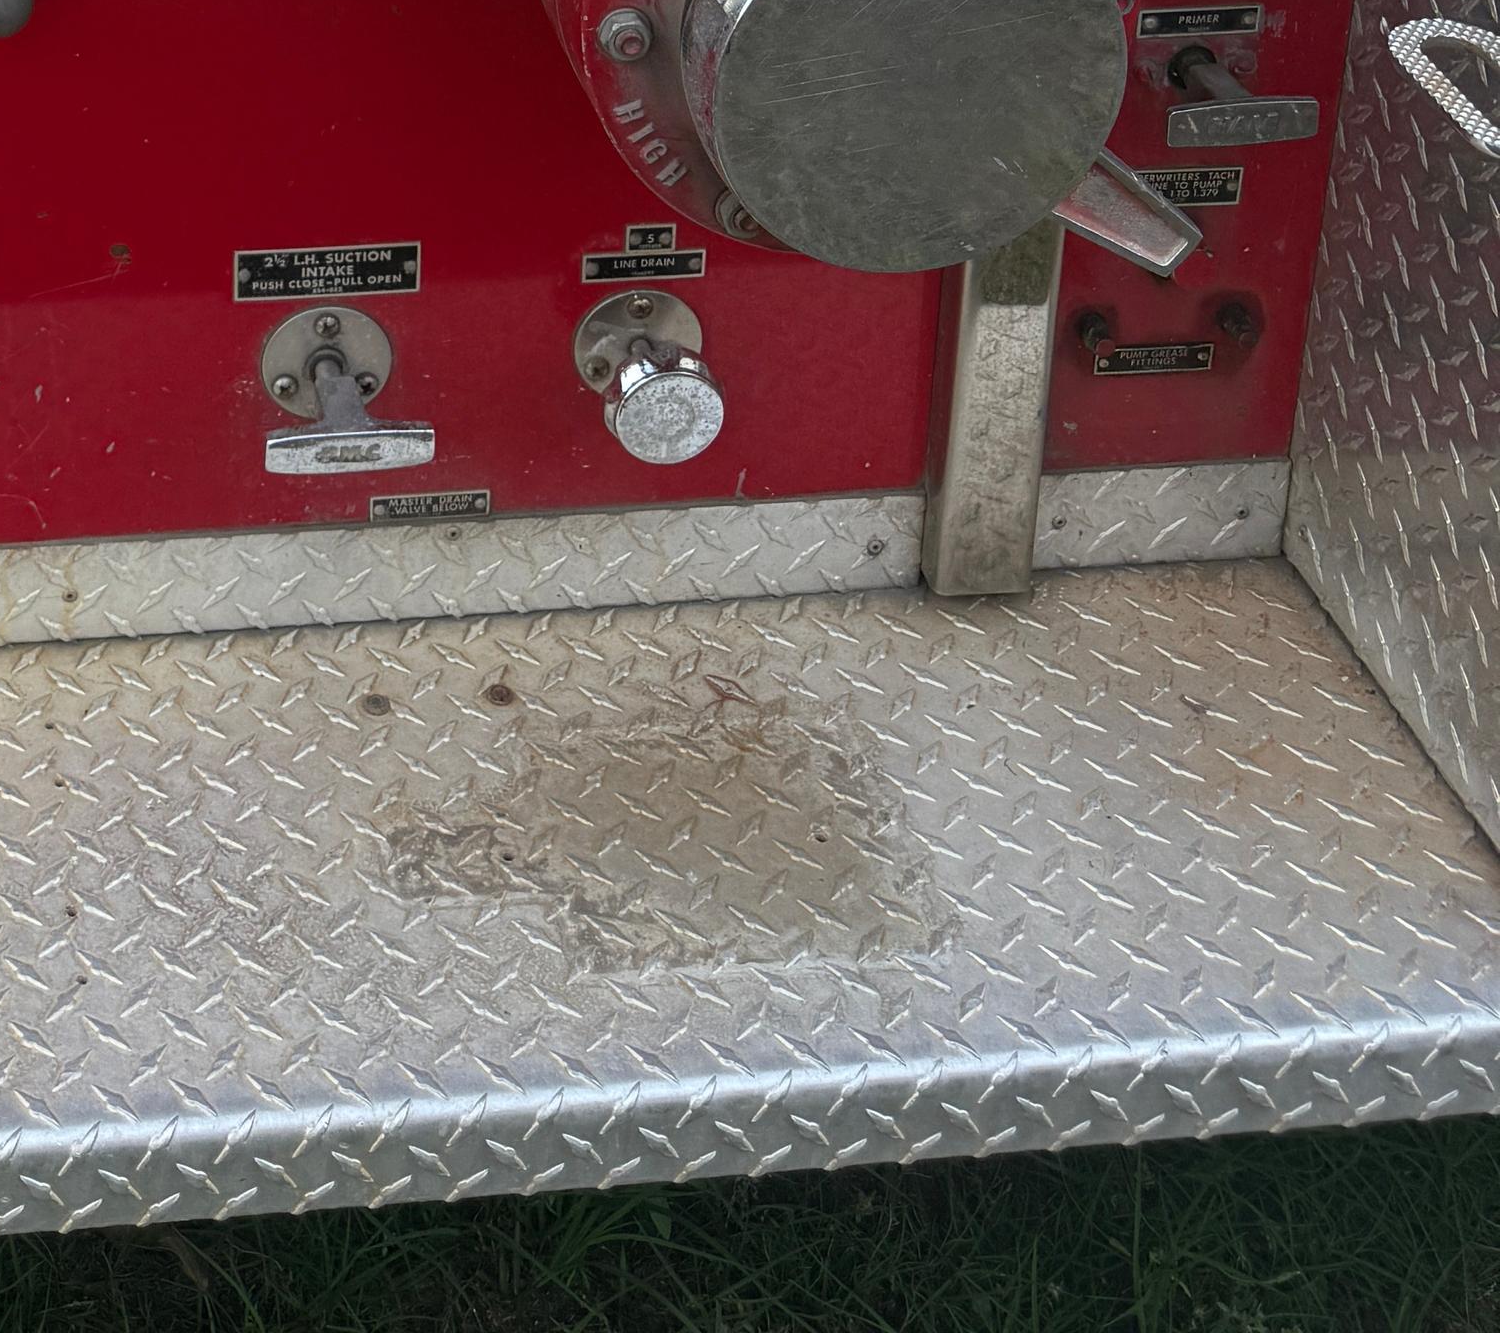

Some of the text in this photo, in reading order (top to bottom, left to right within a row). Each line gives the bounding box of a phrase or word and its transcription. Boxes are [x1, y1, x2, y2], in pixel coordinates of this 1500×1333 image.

[1178, 14, 1219, 24] PRIMER
[614, 101, 689, 187] HIGH
[1194, 189, 1218, 197] 1.379
[647, 234, 654, 244] 5
[326, 250, 392, 263] SUCTION
[613, 257, 675, 268] LINE DRAIN
[301, 266, 353, 277] INTAKE
[252, 274, 401, 290] PUSH OPEN
[1120, 350, 1148, 359] PUMP
[388, 493, 473, 507] MASTER DRAIN
[395, 502, 468, 514] VALVE BELOW
